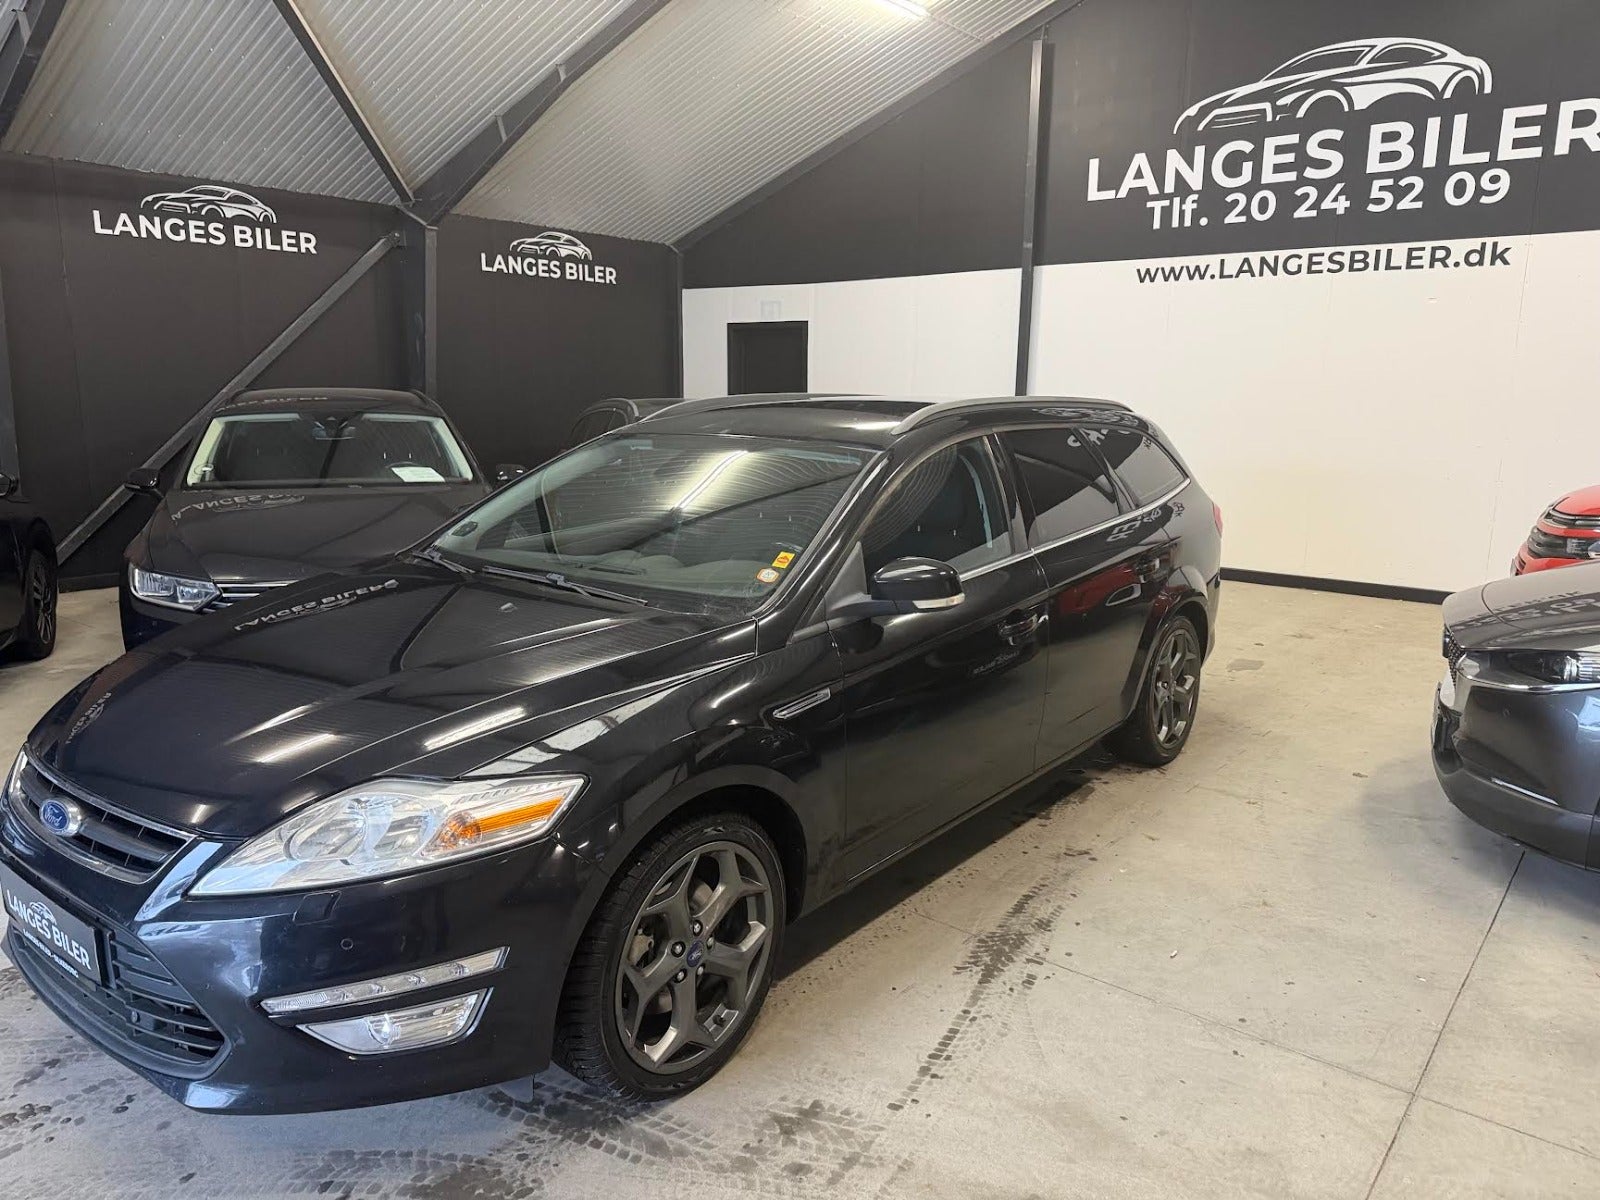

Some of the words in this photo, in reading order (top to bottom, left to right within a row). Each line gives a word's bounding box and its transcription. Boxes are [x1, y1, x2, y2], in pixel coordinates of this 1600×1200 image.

[1087, 129, 1345, 202] LANGES
[1365, 97, 1600, 174] BILER
[1146, 194, 1209, 230] Tlf.
[1223, 189, 1277, 224] 20
[1293, 182, 1350, 219] 24
[1366, 176, 1424, 213] 52
[1444, 168, 1511, 206] 09
[92, 209, 227, 246] LANGES
[233, 224, 318, 255] BILER
[480, 252, 561, 279] LANGES
[565, 262, 617, 285] BILER
[1136, 241, 1512, 284] www.LANGESBILER.dk
[45, 805, 63, 827] Ford
[7, 889, 51, 939] LANGES
[51, 925, 92, 970] BILER
